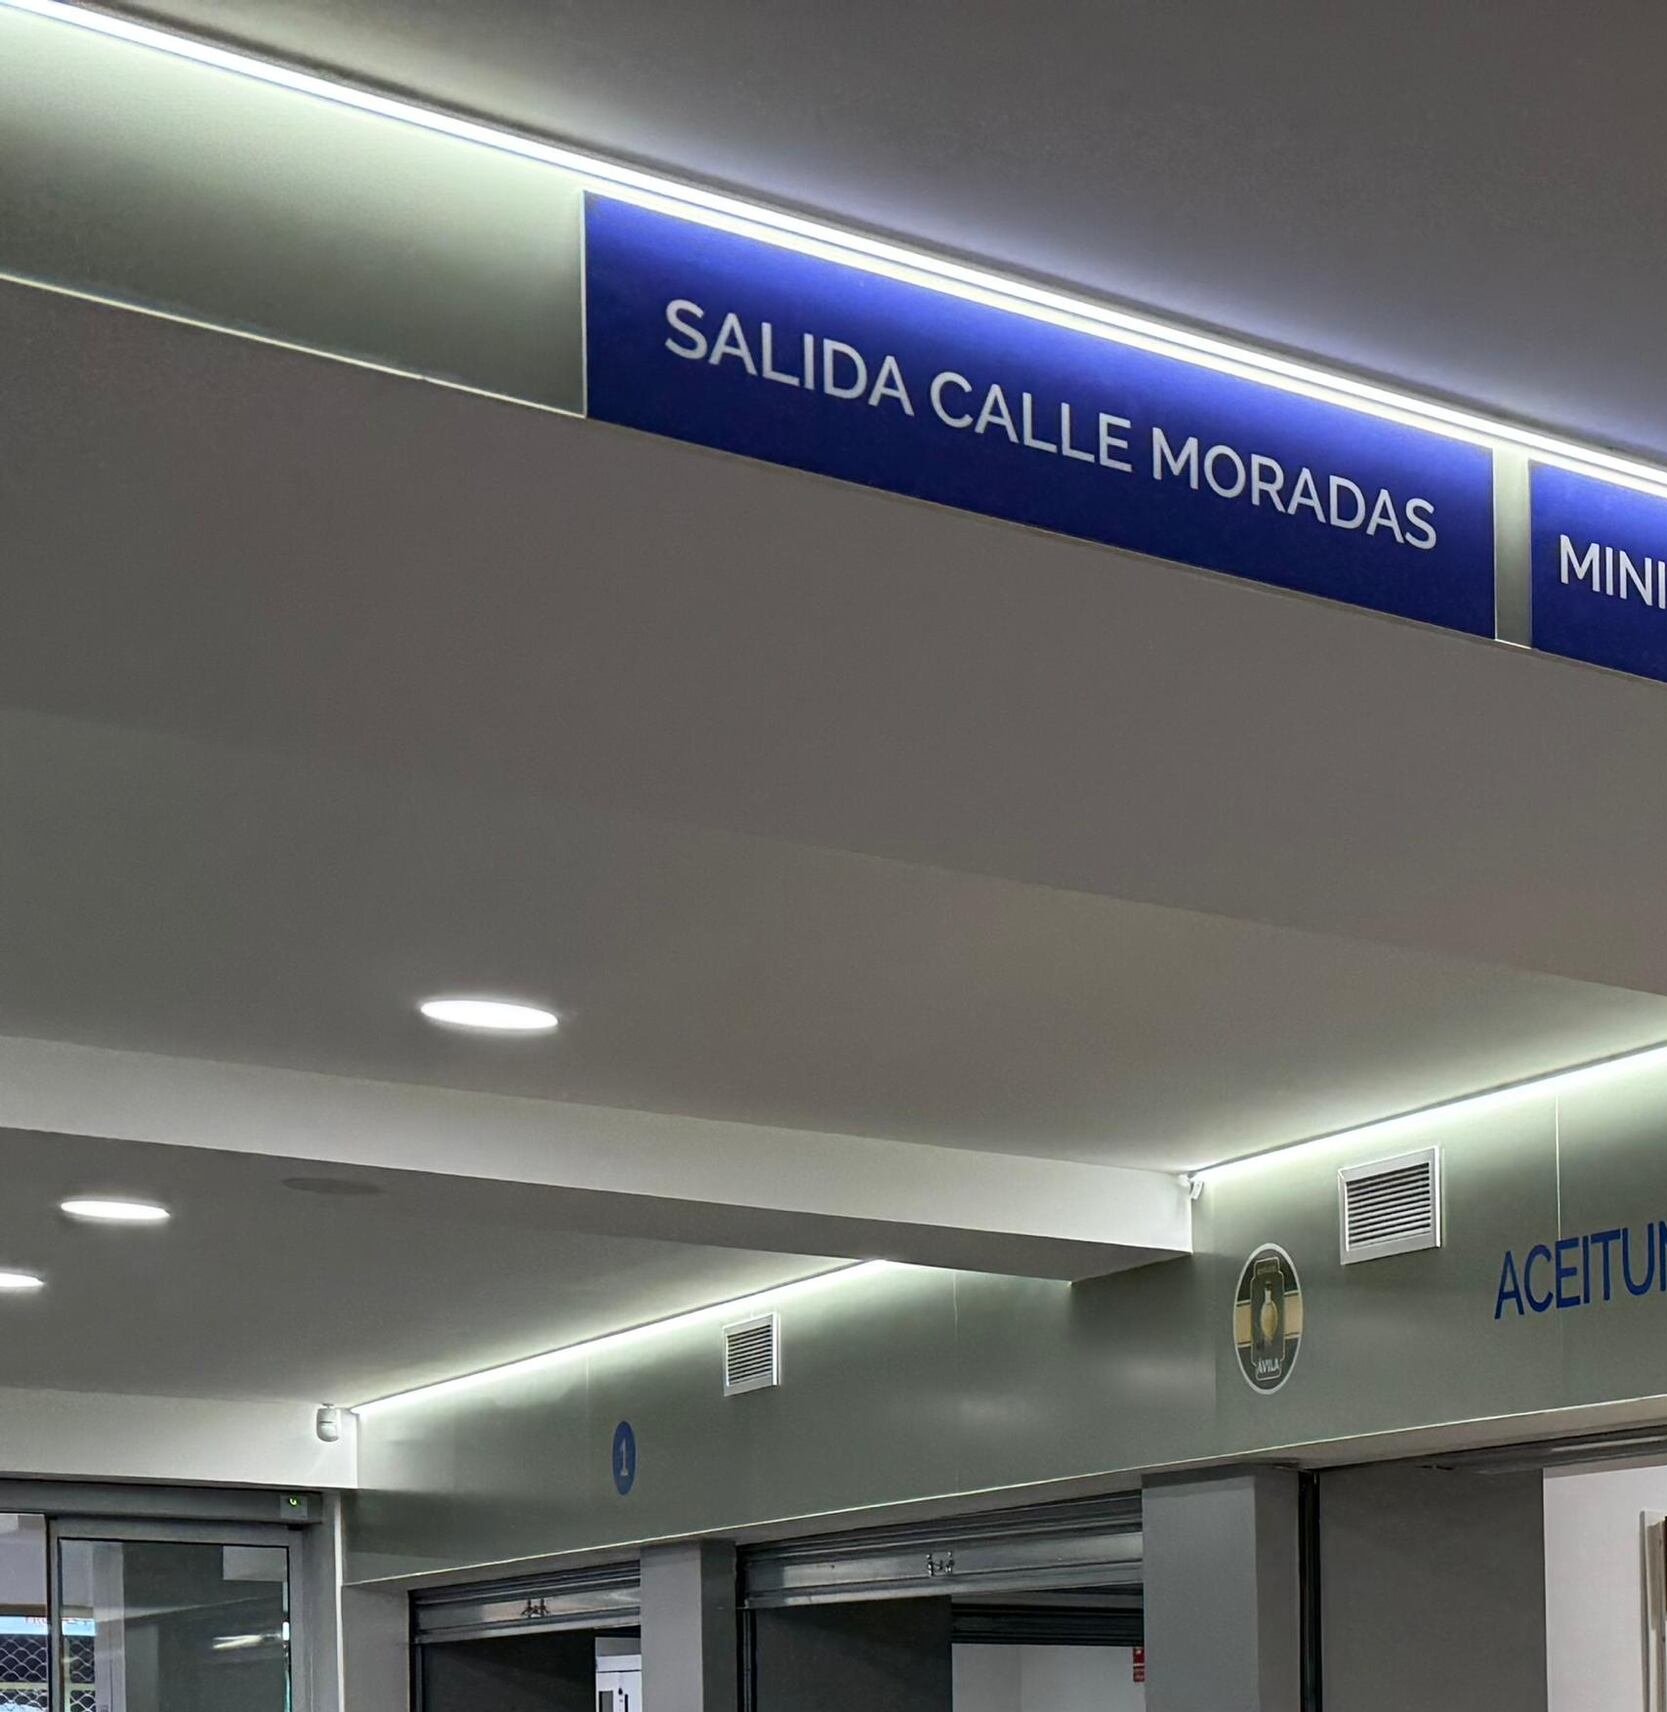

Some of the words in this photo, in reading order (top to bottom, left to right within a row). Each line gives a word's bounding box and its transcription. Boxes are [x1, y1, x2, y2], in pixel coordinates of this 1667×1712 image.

[665, 299, 915, 416] SALIDA
[930, 372, 1133, 473] CALLE
[1152, 427, 1438, 550] MORADAS
[619, 1437, 629, 1477] 1
